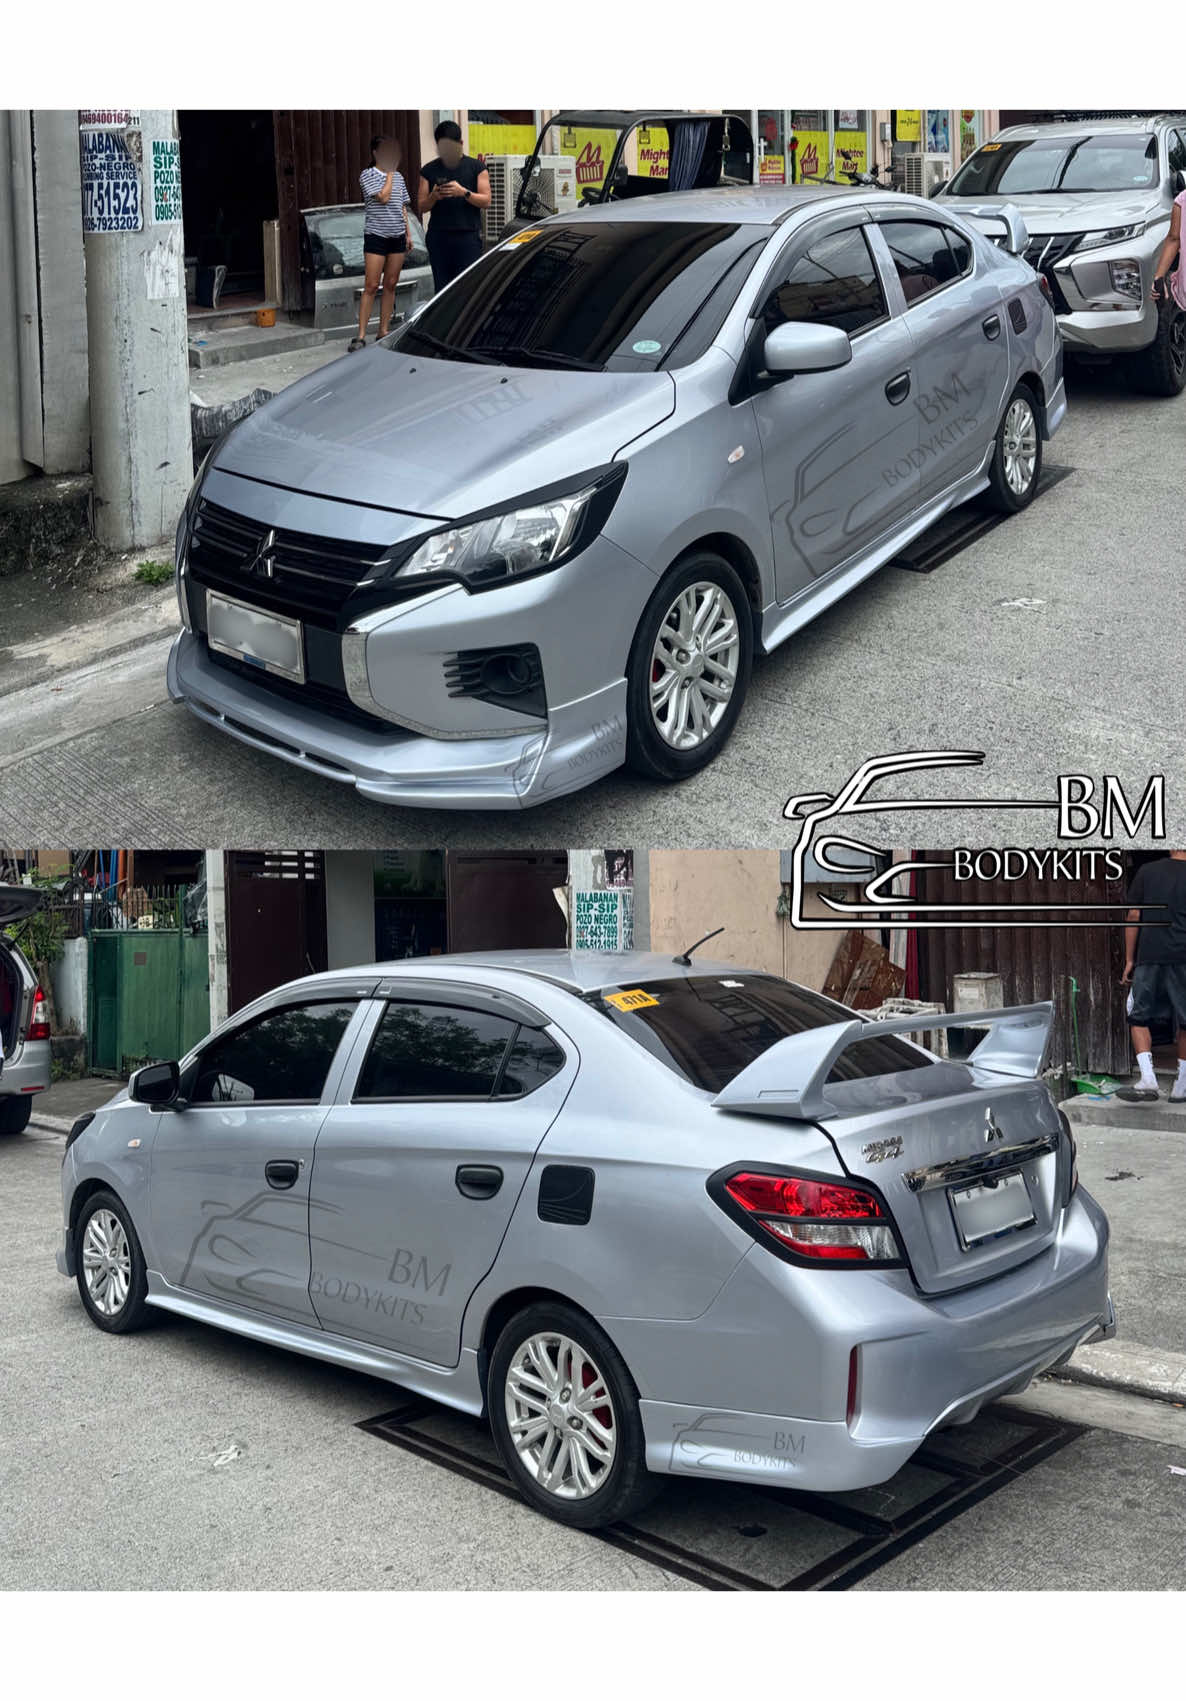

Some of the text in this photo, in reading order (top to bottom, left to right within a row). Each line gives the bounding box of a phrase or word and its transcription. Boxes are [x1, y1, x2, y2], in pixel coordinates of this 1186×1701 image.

[105, 171, 137, 180] SERVICE
[650, 164, 669, 176] Mar
[154, 170, 174, 184] POZO
[576, 903, 618, 913] SIP-SIP
[576, 914, 618, 925] POZO NEGRO
